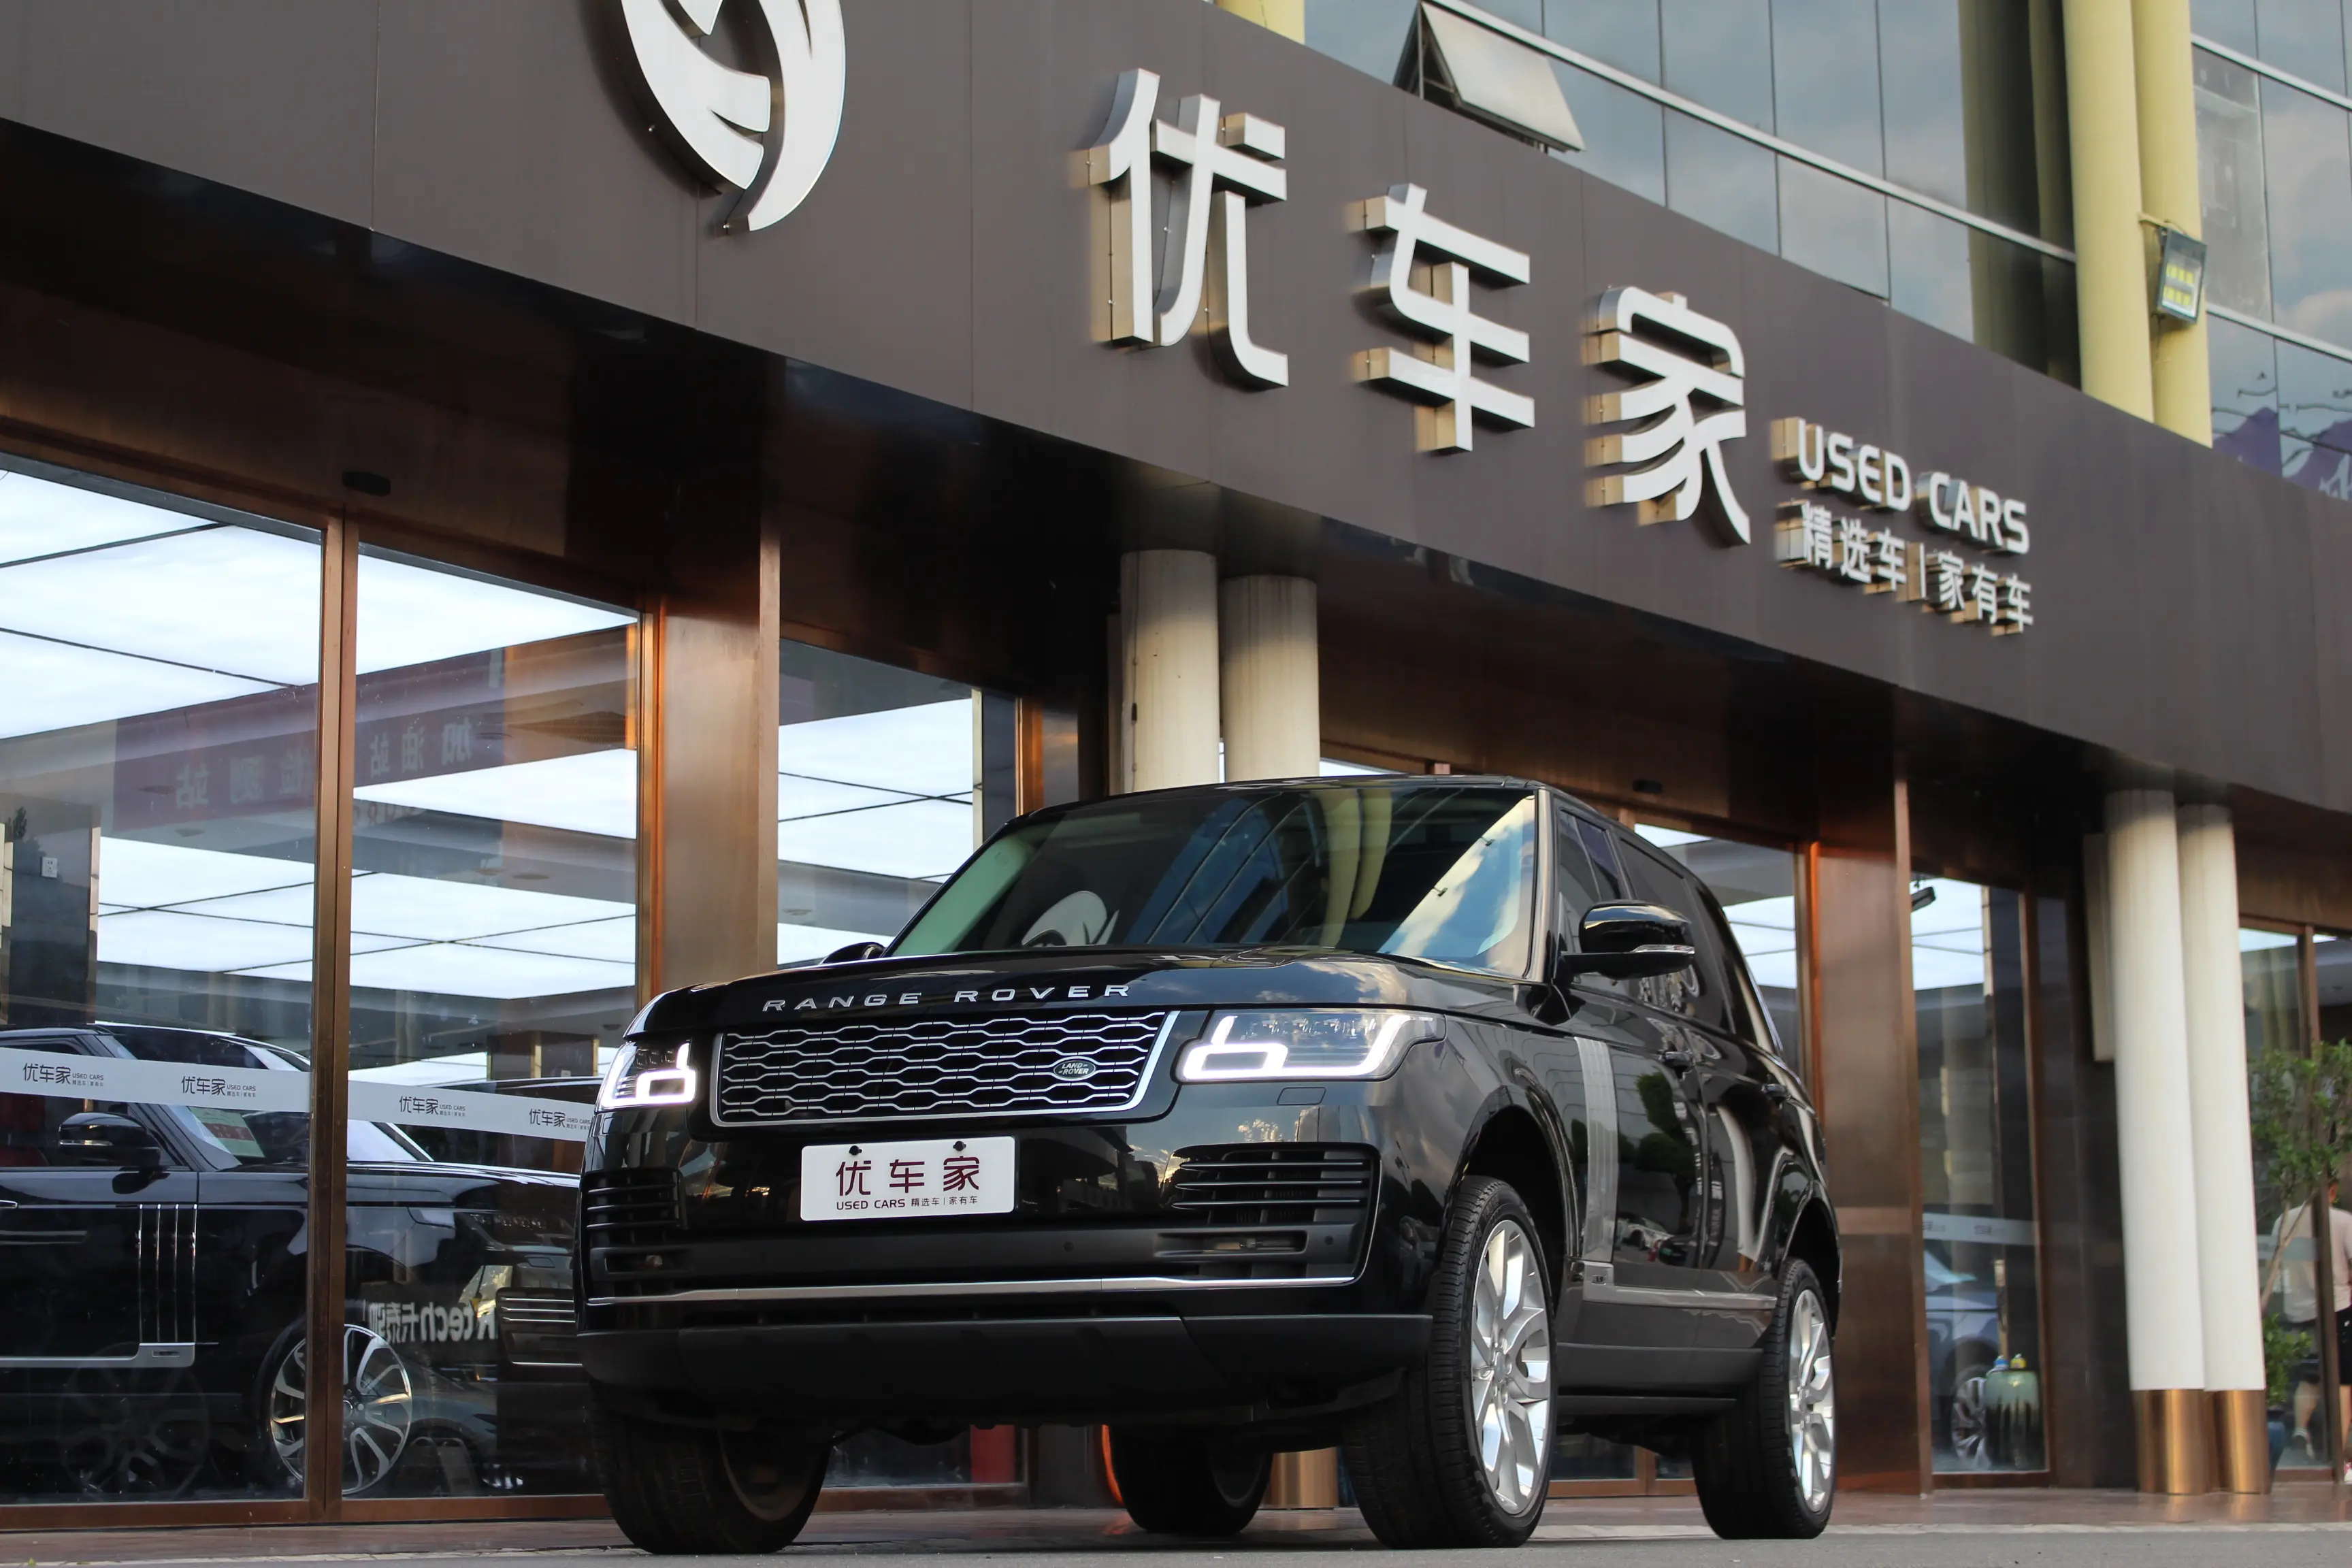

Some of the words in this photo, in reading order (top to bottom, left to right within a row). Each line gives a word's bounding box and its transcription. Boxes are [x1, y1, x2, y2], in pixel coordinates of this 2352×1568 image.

[1106, 67, 1750, 544] 优车家
[1795, 418, 1911, 512] USED
[1928, 472, 2030, 555] CARS
[762, 992, 921, 1012] RANGE
[953, 985, 1130, 1002] ROVER
[22, 1062, 71, 1085] 优车家
[181, 1076, 225, 1096] 优车家
[399, 1096, 438, 1115] 优车家
[529, 1108, 566, 1128] 优车家
[836, 1156, 979, 1196] 优车家
[836, 1200, 868, 1210] USED
[874, 1198, 906, 1209] CARS
